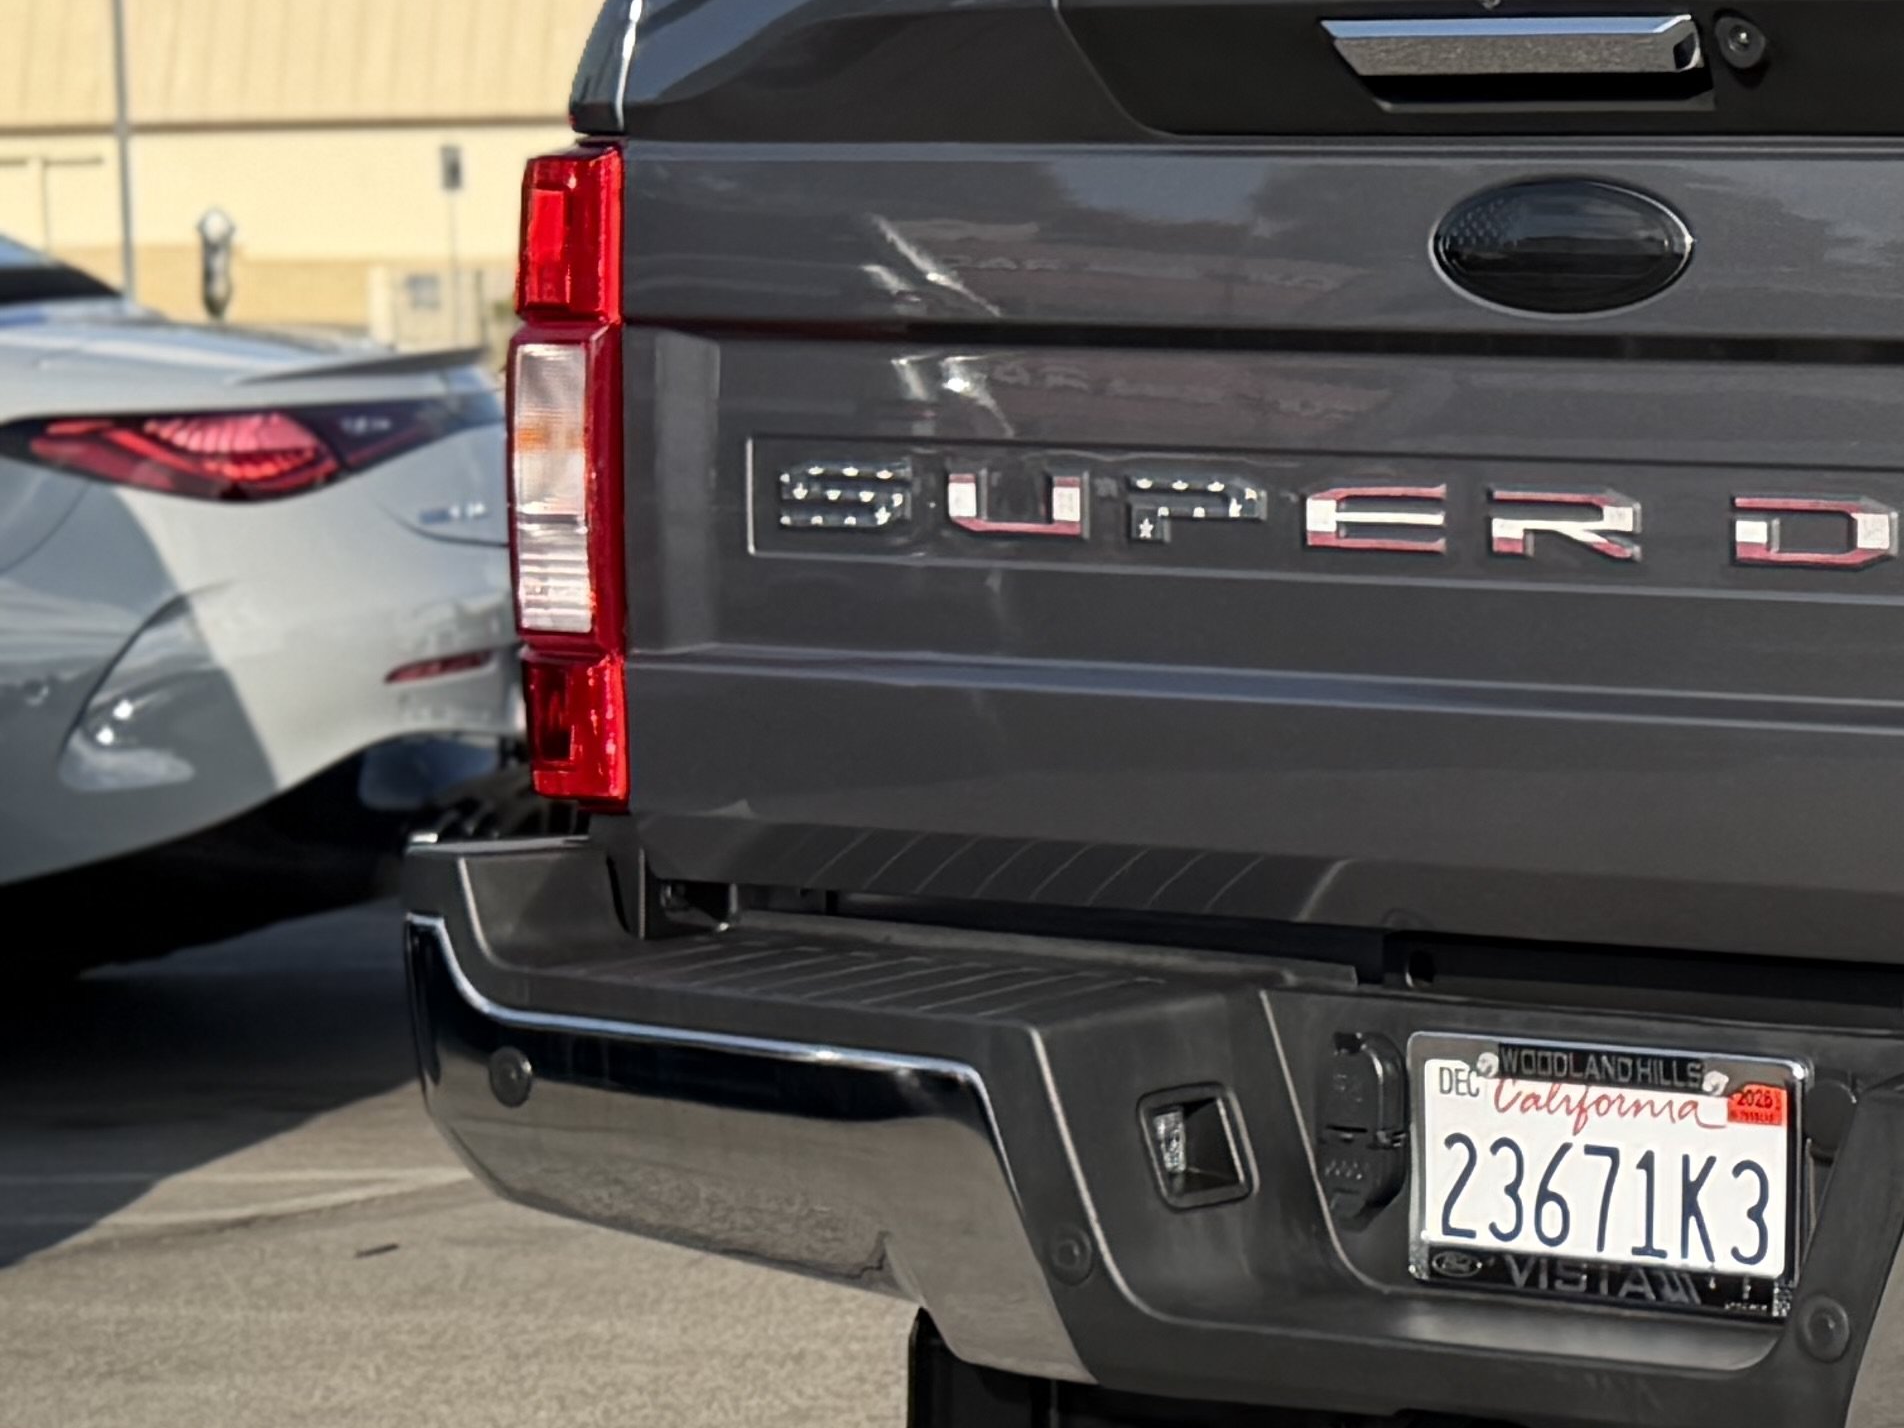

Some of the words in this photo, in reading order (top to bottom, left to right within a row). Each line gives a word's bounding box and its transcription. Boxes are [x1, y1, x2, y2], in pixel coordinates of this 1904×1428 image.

[780, 462, 1645, 564] SUPER
[1438, 1066, 1480, 1098] DEC
[1502, 1048, 1634, 1086] WOODLAND
[1636, 1059, 1701, 1089] HILLS
[1493, 1076, 1727, 1136] California
[1441, 1133, 1770, 1266] 23671K3
